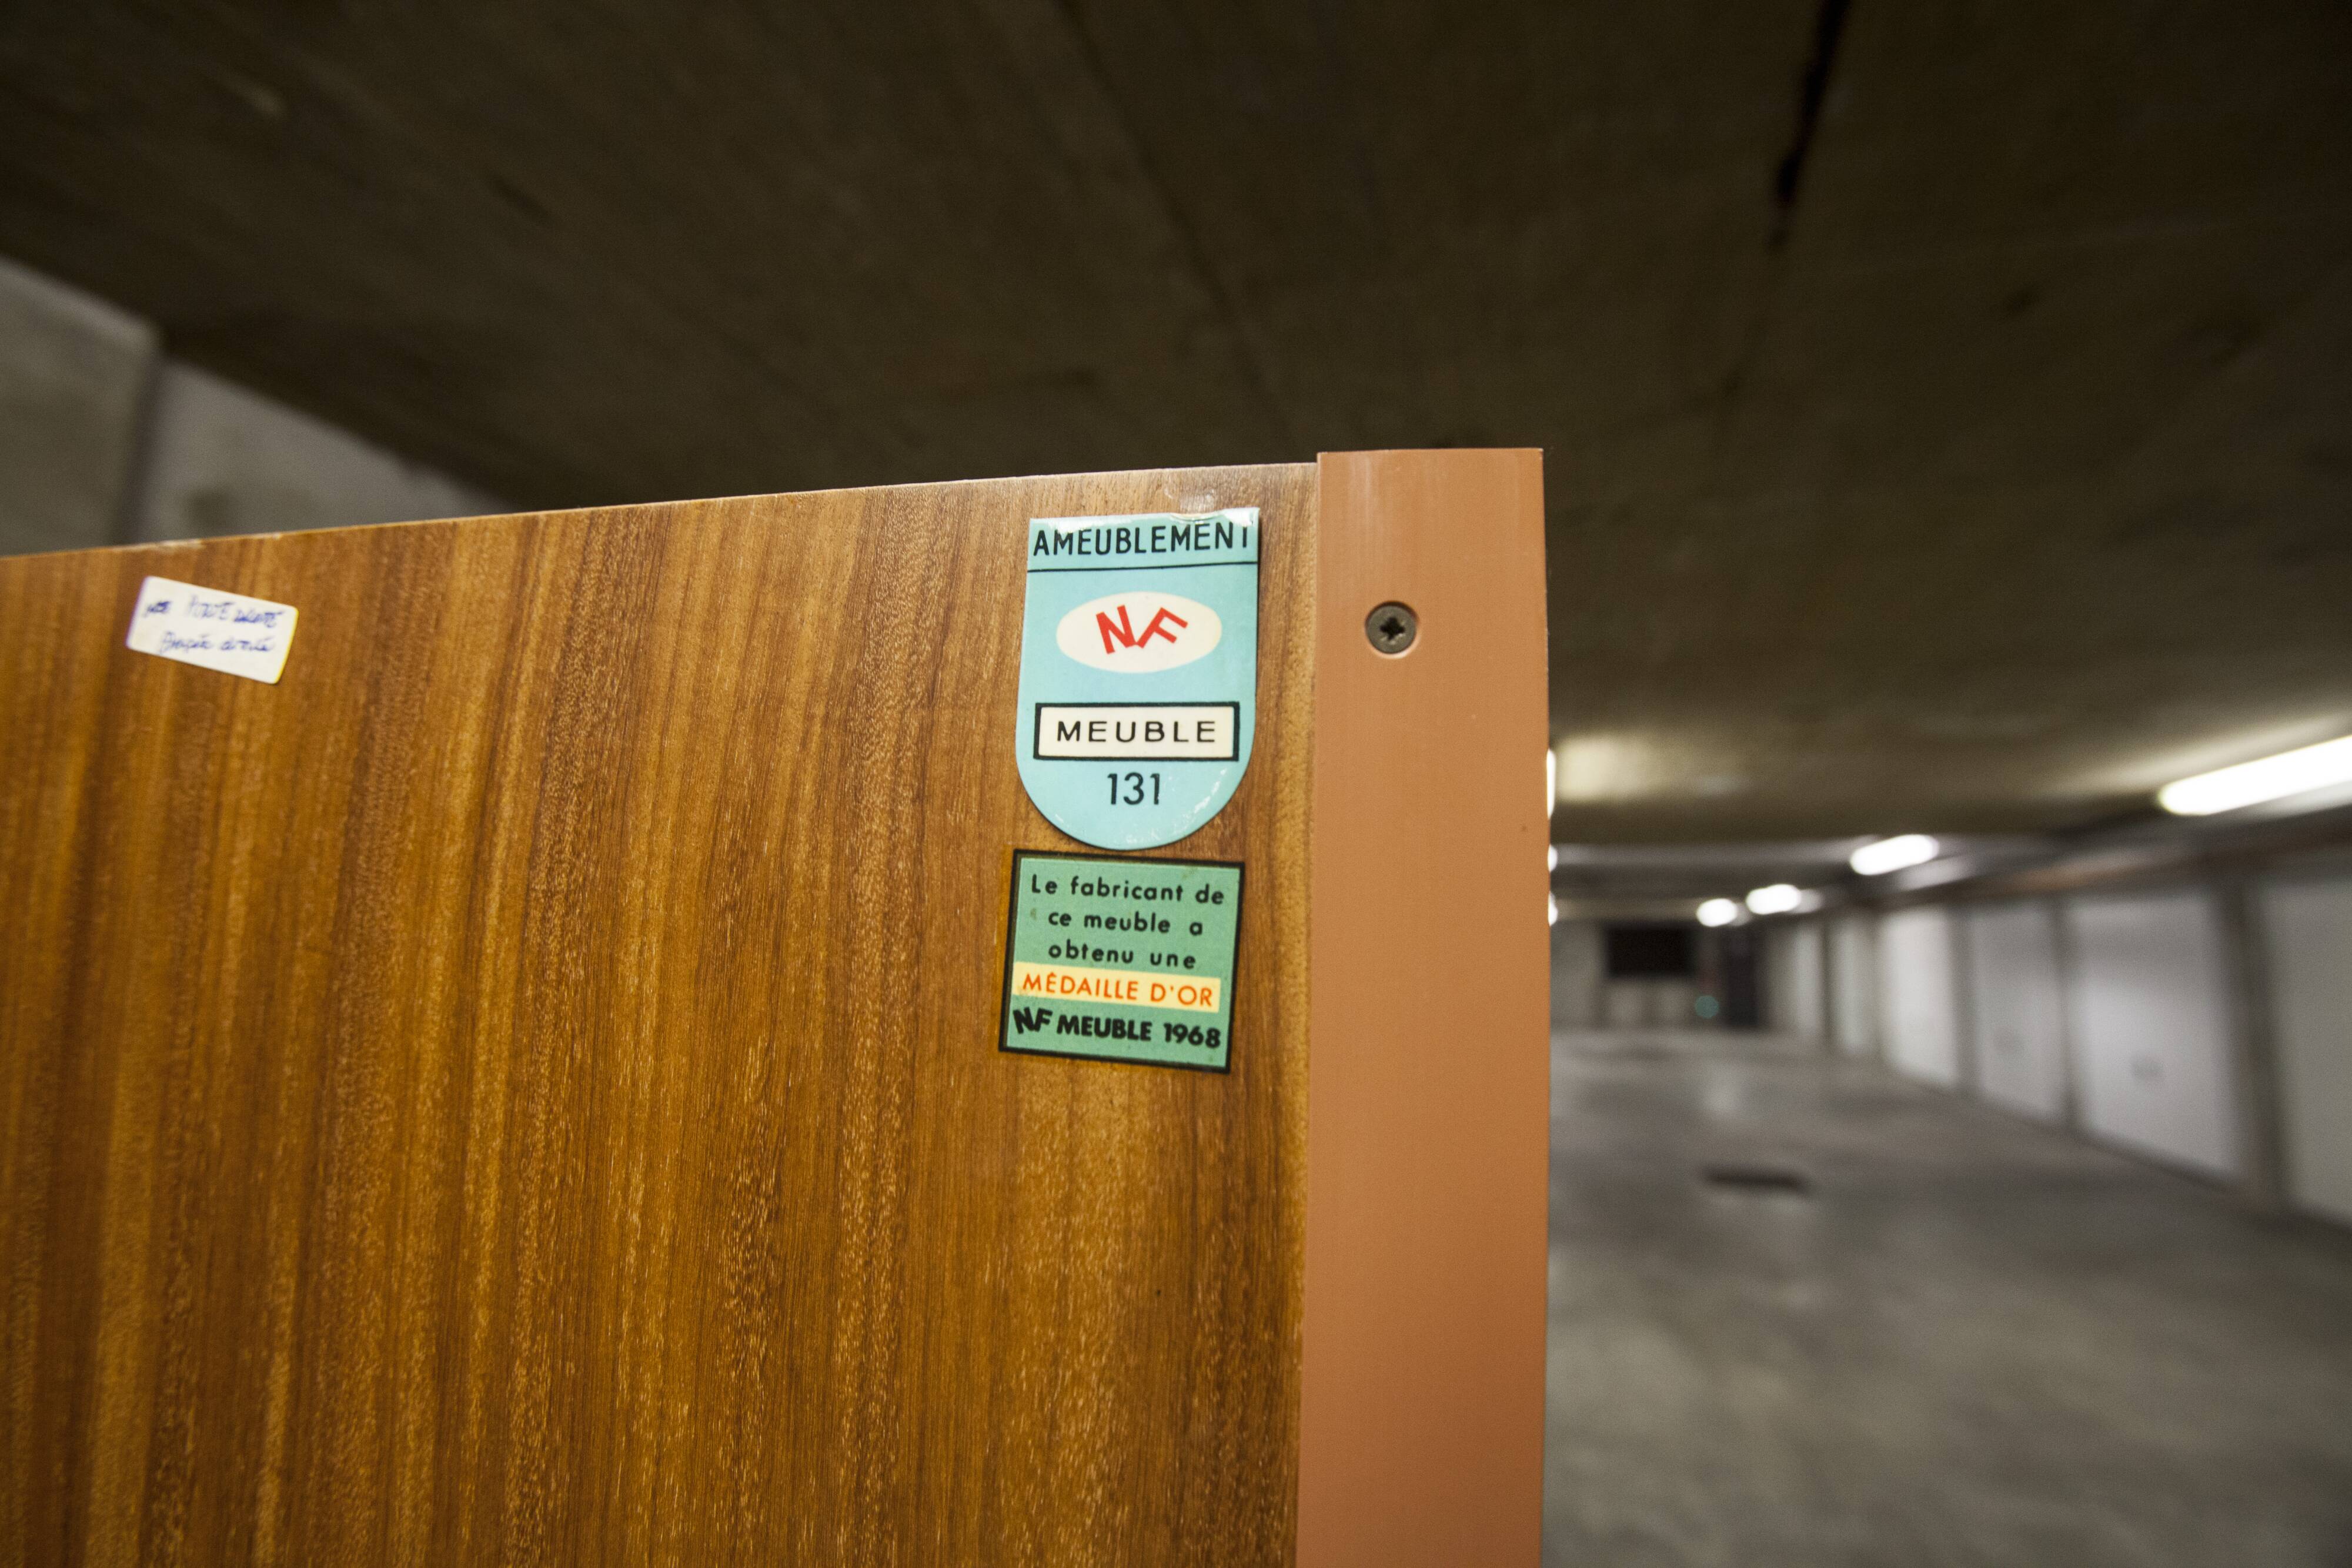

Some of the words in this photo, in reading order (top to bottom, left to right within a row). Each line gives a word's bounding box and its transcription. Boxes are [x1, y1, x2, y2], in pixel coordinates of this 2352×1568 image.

[1095, 605, 1188, 654] NF
[1057, 721, 1215, 743] MEUBLE
[1107, 772, 1160, 805] 131
[1031, 874, 1058, 895] Le
[1070, 875, 1184, 902] fabricant
[1195, 883, 1225, 905] de
[1048, 911, 1072, 927] ce
[1084, 911, 1171, 934] meuble
[1189, 921, 1203, 936] a
[1048, 939, 1134, 964] obtenu
[1150, 952, 1196, 969] une
[1150, 982, 1212, 1007] D'OR
[1013, 1006, 1053, 1034] NF
[1057, 1014, 1152, 1042] MEUBLE
[1163, 1021, 1221, 1049] 1968
